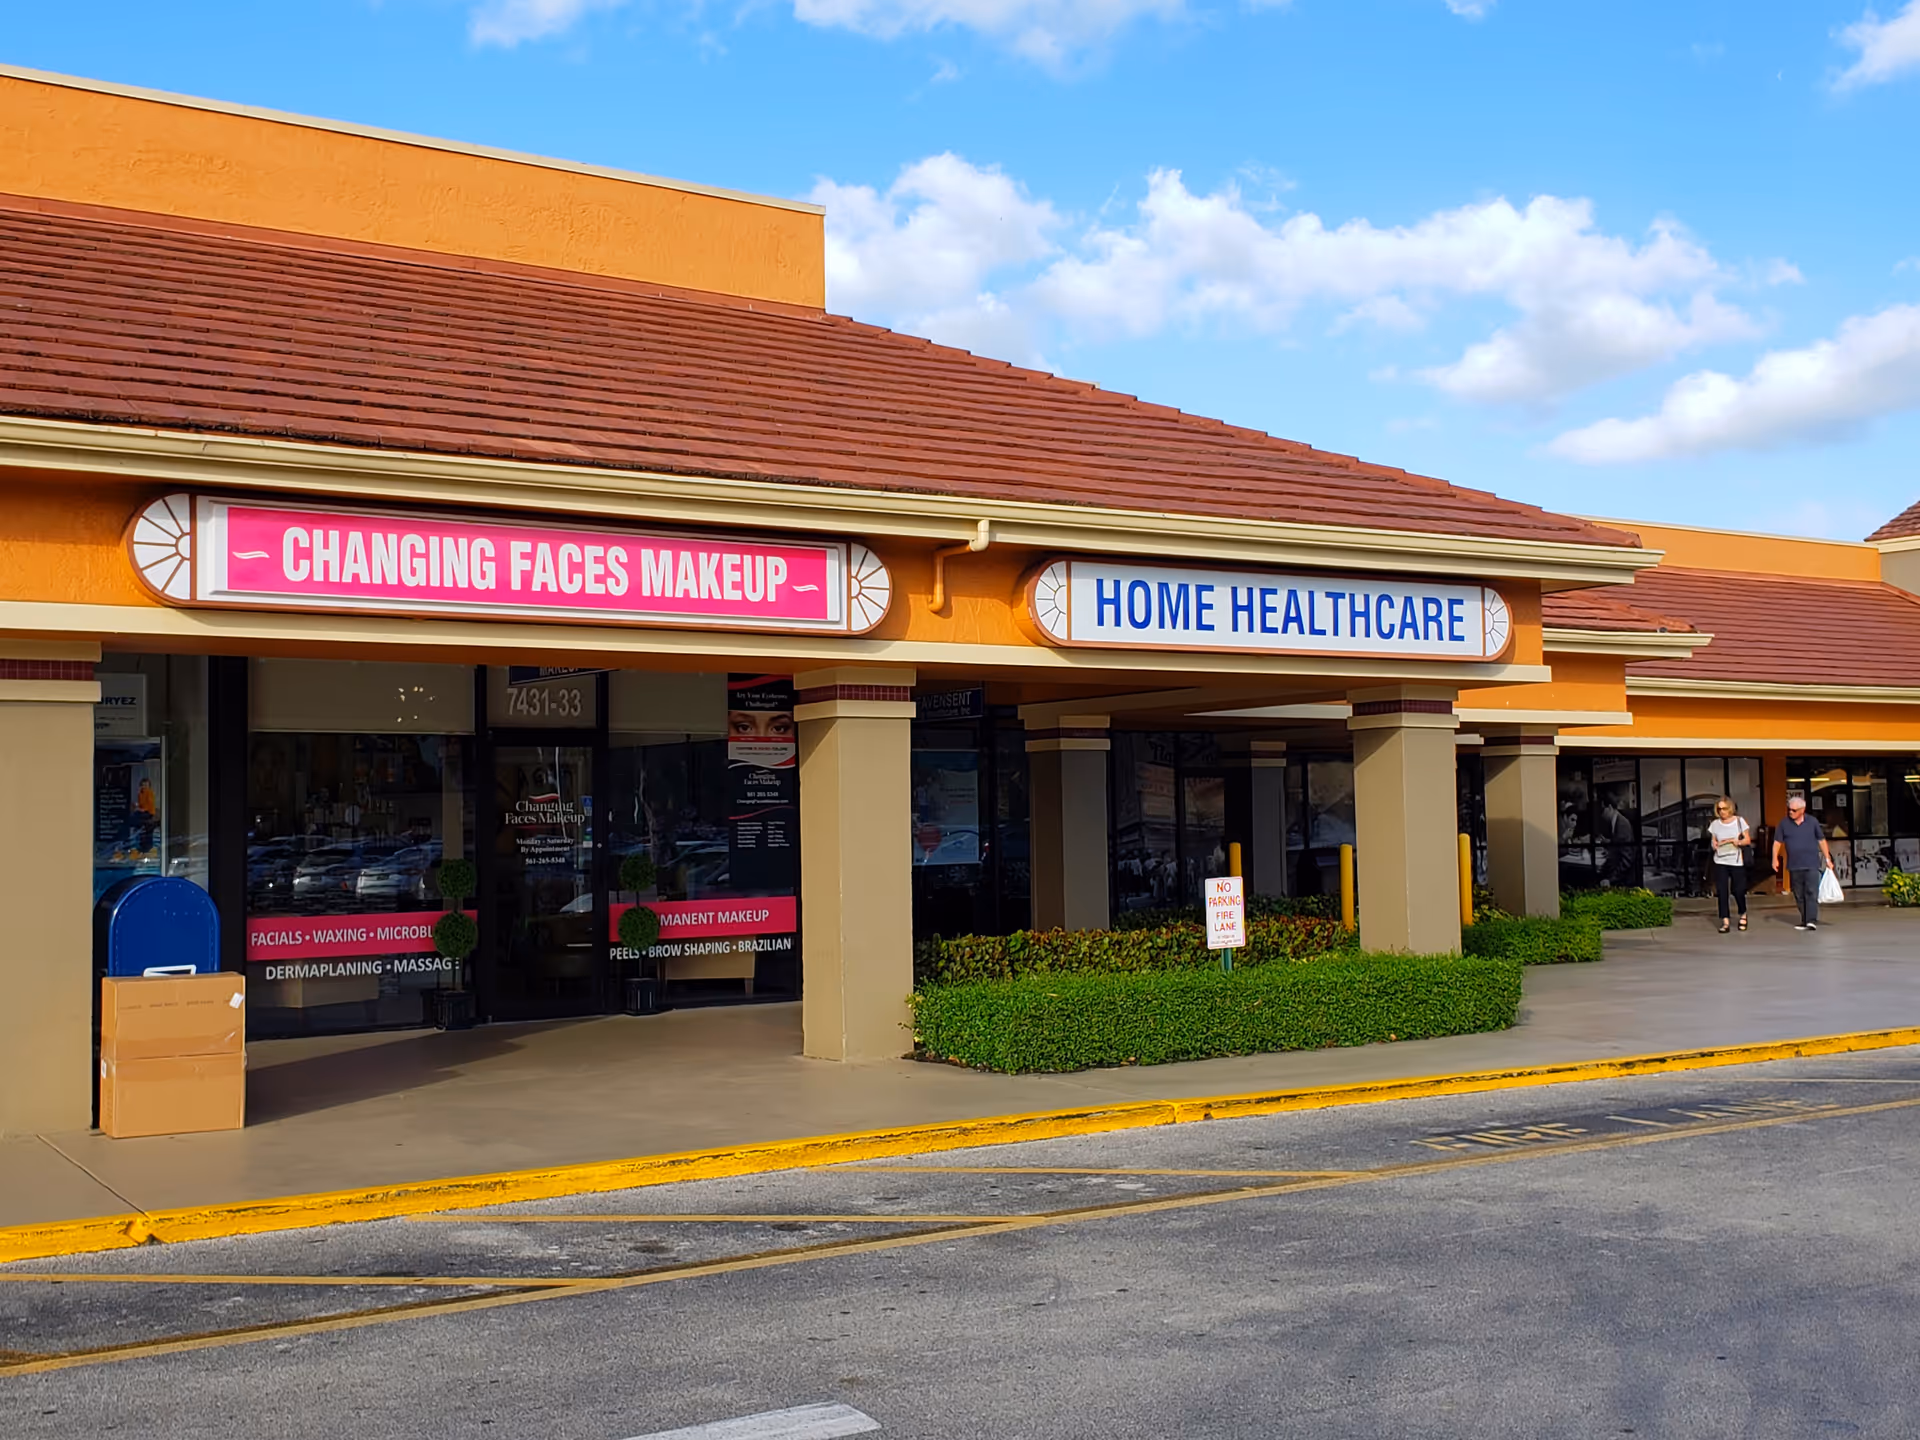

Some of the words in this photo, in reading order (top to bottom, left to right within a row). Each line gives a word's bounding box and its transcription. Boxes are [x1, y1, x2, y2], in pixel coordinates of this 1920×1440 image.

[281, 525, 497, 591] CHANGING
[509, 540, 629, 597] FACES
[640, 547, 788, 603] MAKEUP
[1096, 577, 1215, 632] HOME
[1231, 585, 1466, 643] HEALTHCARE
[101, 696, 137, 705] RYEZ
[507, 687, 582, 717] 7431-33
[515, 799, 574, 813] Changing
[505, 812, 538, 825] Faces
[538, 812, 585, 826] Makeup
[516, 838, 542, 846] Monday
[546, 837, 575, 846] Saturday
[1216, 881, 1232, 893] NO
[1208, 894, 1241, 908] PARKING
[659, 911, 715, 927] MANENT
[717, 909, 769, 924] MAKEUP
[1216, 910, 1235, 920] FIRE
[1214, 921, 1237, 932] LANE
[250, 929, 303, 947] FACIALS
[312, 927, 367, 944] WAXING
[376, 925, 434, 941] MICROBL
[648, 943, 682, 959] BROW
[684, 940, 731, 956] SHAPING
[738, 936, 792, 953] BRAZILIAN
[265, 960, 383, 981] DERMAPLANING
